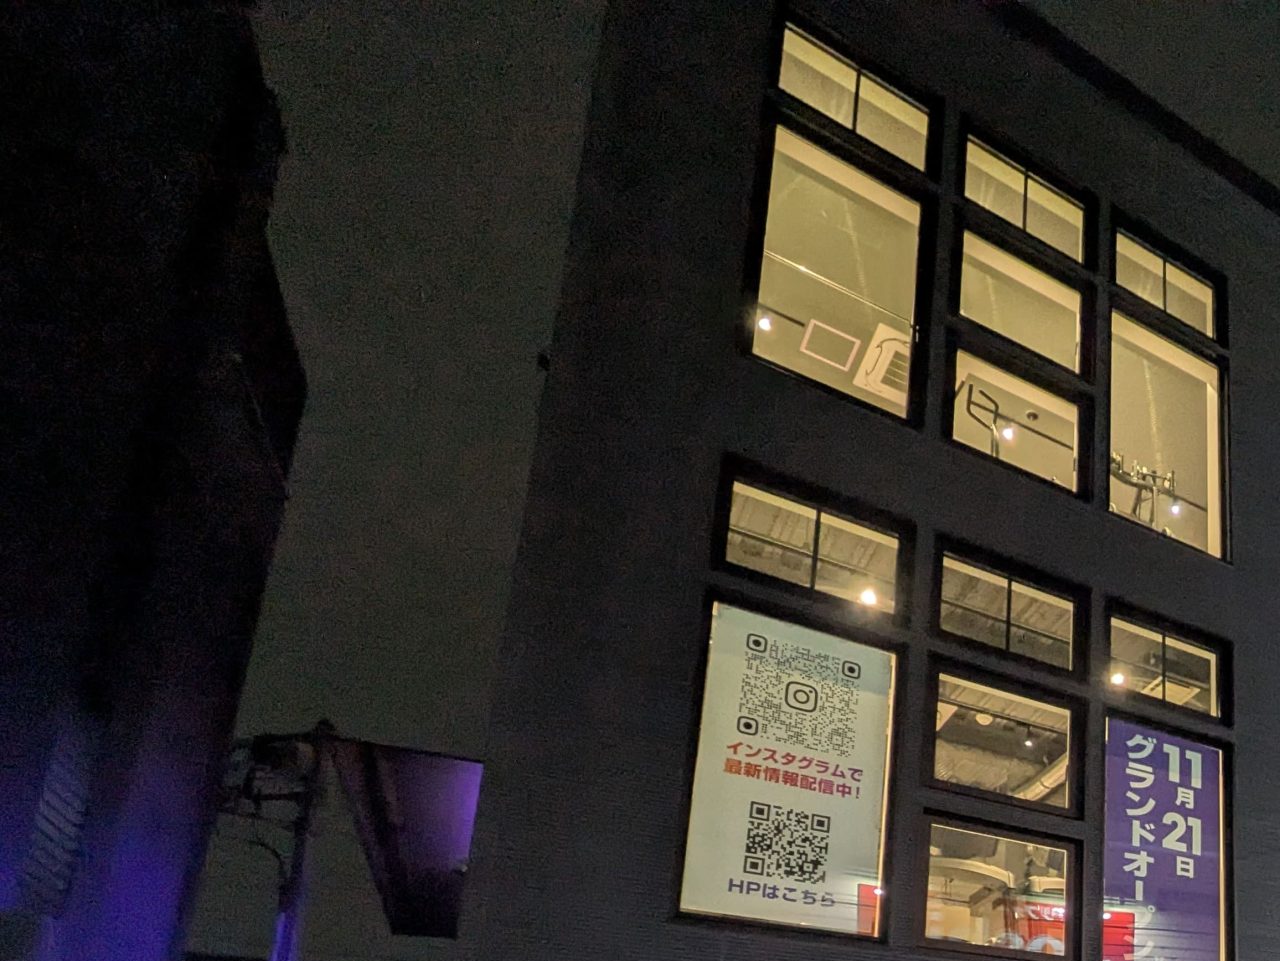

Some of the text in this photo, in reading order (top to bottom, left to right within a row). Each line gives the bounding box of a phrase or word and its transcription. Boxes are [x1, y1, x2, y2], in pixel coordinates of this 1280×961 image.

[727, 741, 864, 783] インスタグラムで
[1122, 733, 1157, 961] グランドオープン
[1162, 743, 1202, 879] 11月21日
[728, 878, 836, 908] HPはこちら
